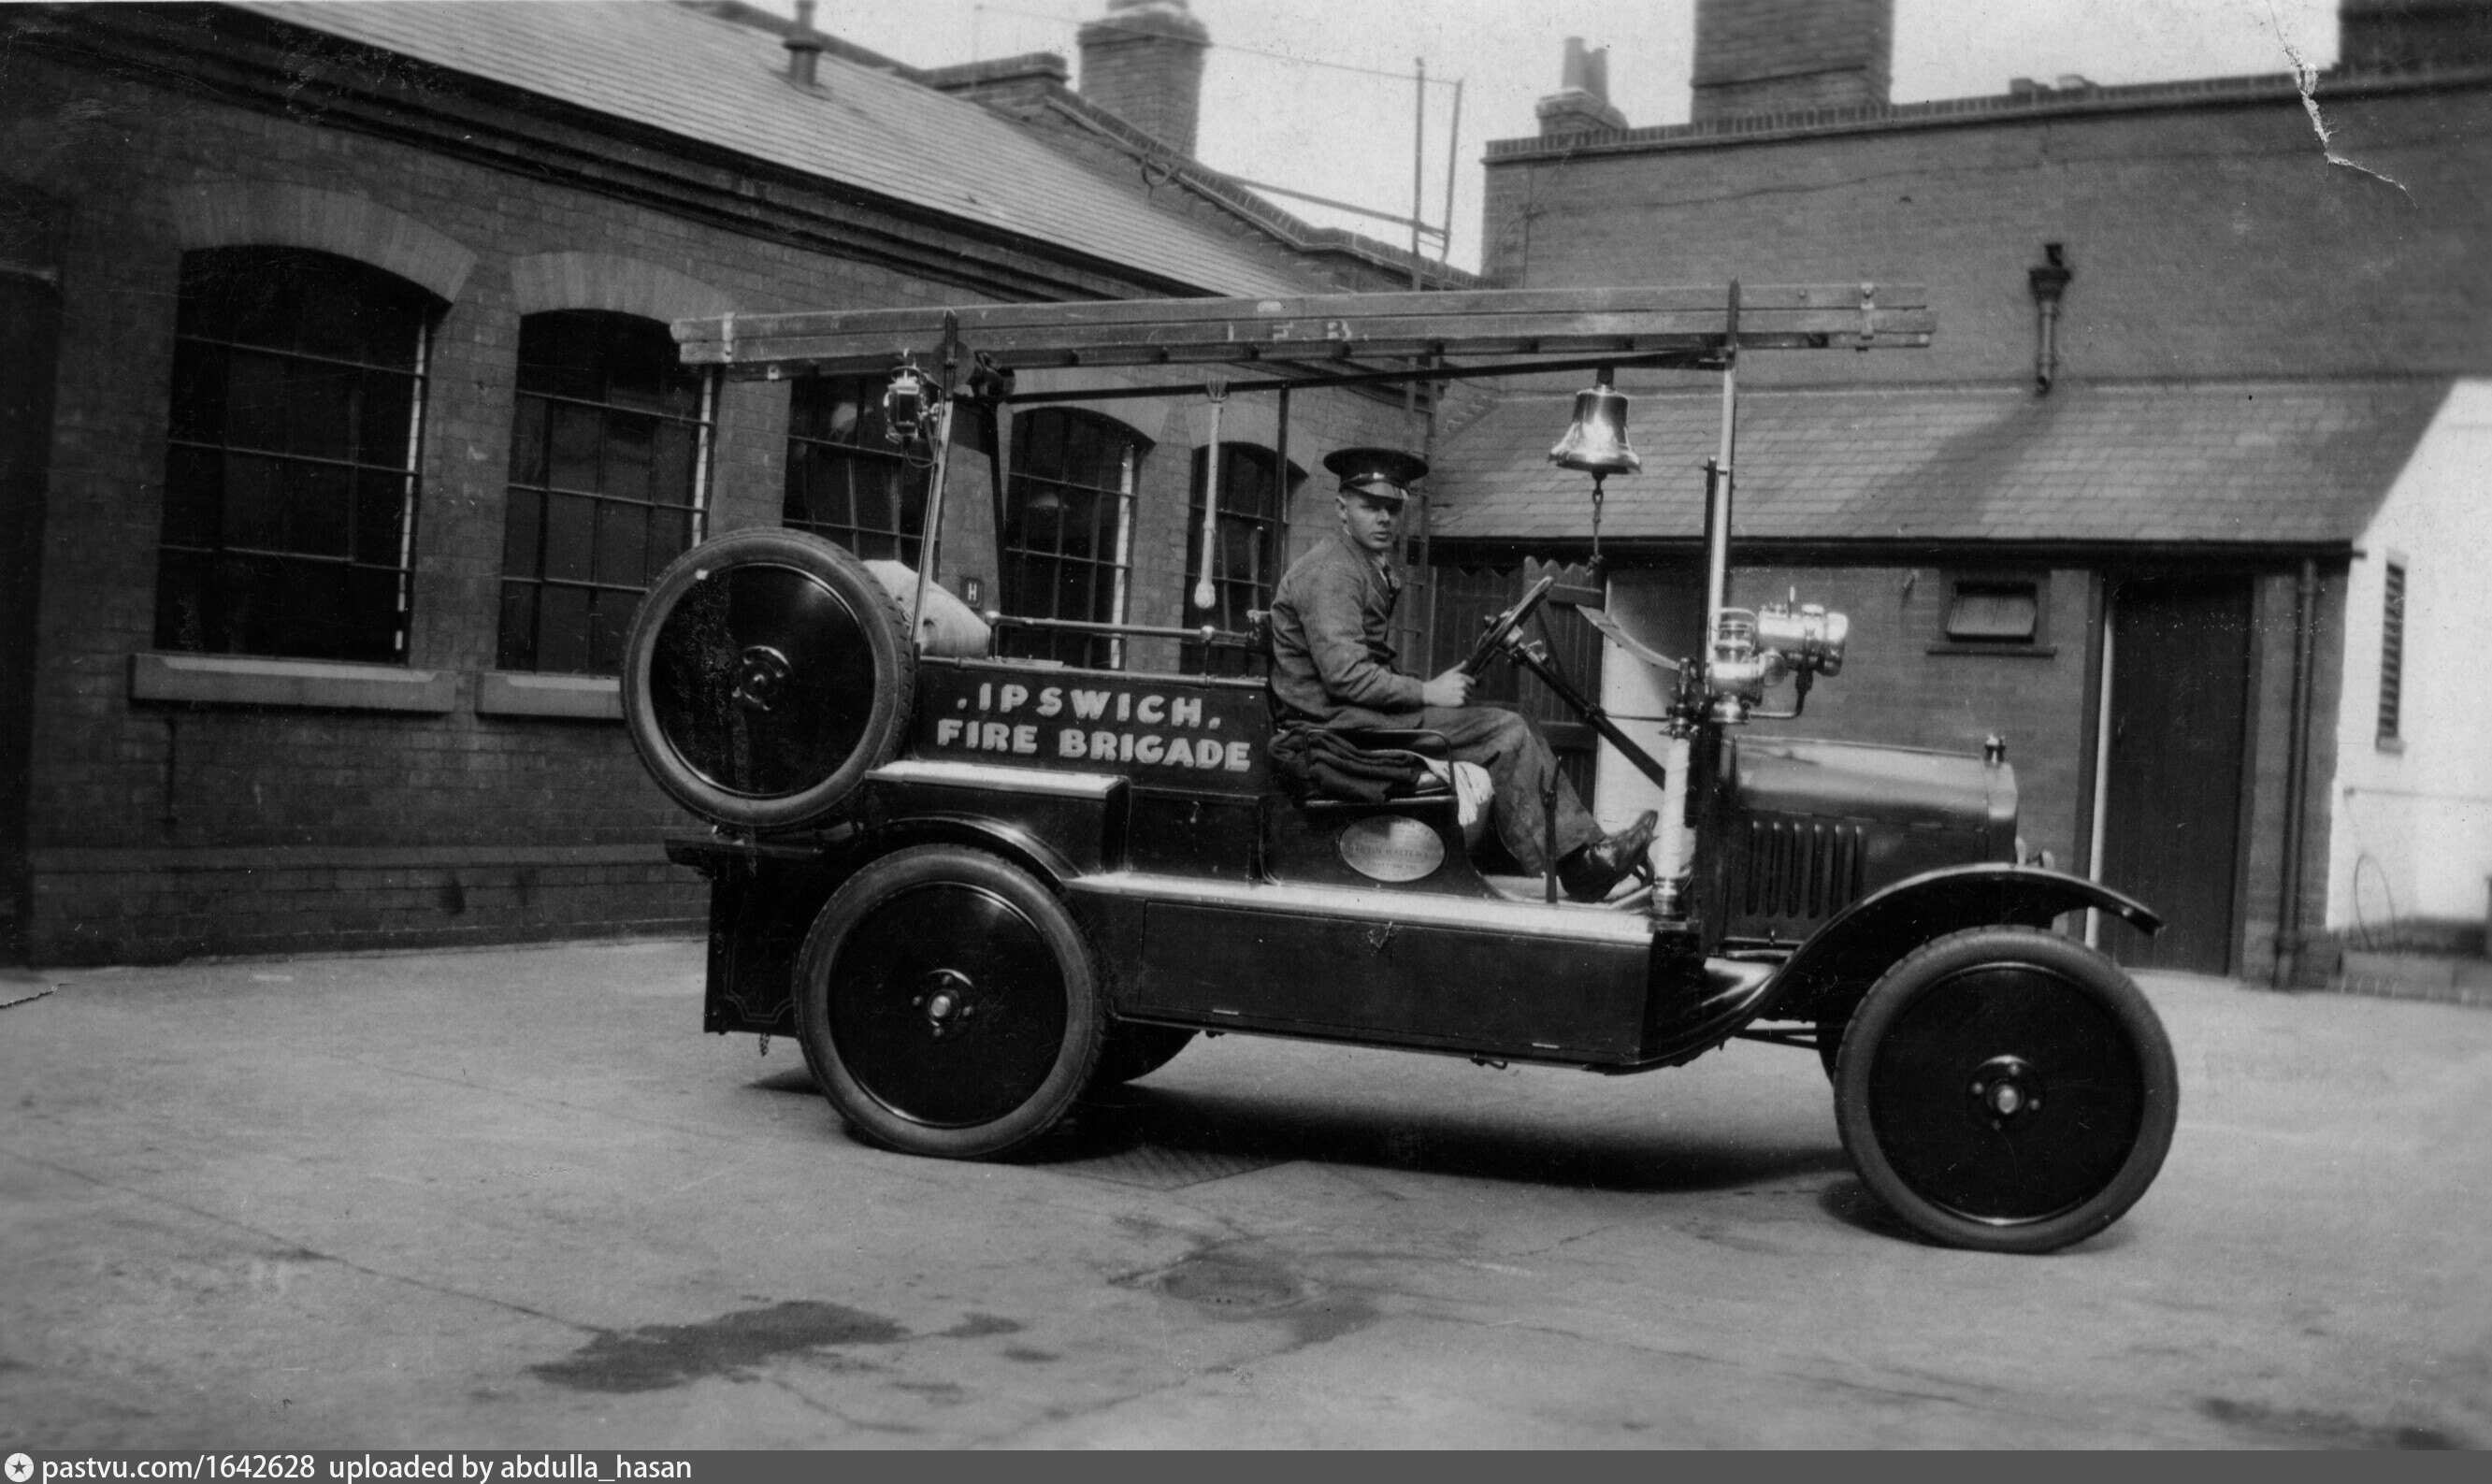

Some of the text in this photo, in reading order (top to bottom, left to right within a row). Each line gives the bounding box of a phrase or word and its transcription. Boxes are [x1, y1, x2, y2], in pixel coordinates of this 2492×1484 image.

[967, 583, 978, 601] H
[936, 718, 1251, 772] FIRE BRIGADE
